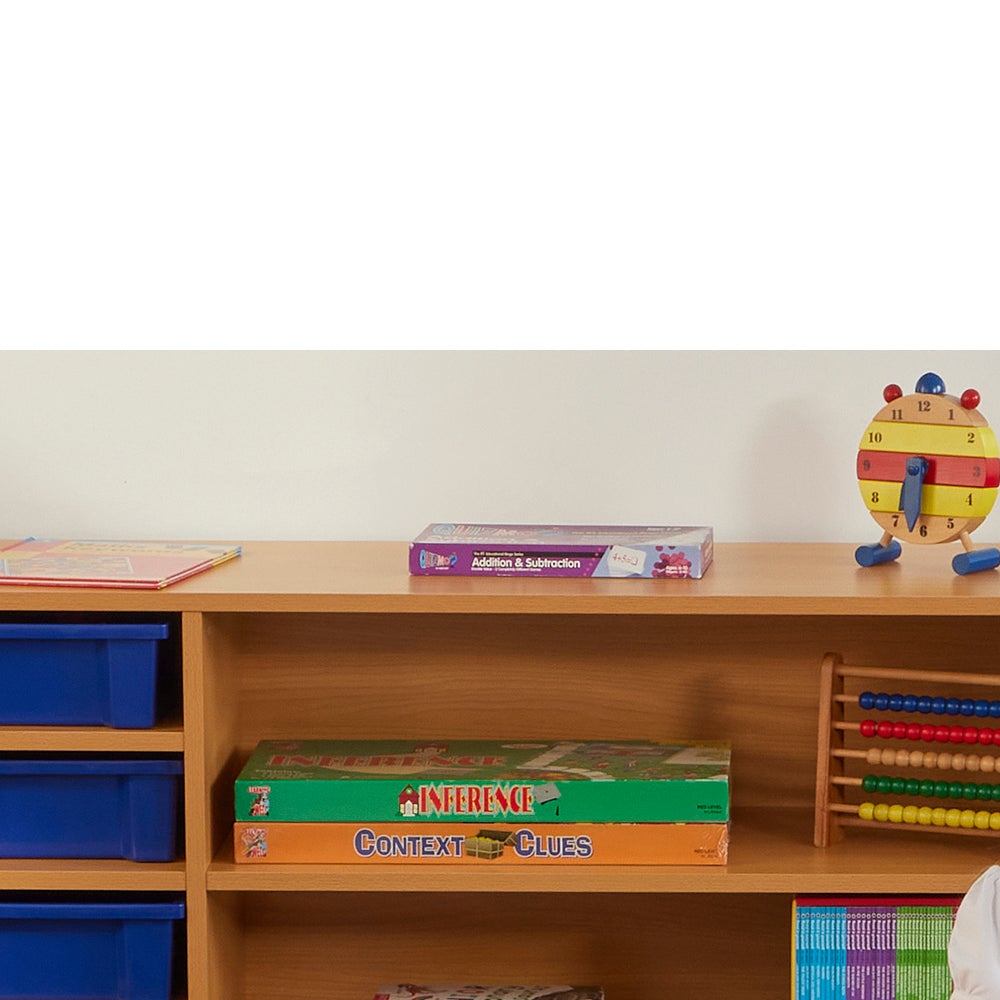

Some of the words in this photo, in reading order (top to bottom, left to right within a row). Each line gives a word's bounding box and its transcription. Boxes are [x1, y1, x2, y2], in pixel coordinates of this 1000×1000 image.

[918, 401, 931, 412] 12
[892, 409, 903, 420] 11
[948, 409, 954, 420] 1
[868, 432, 882, 443] 10
[967, 433, 975, 443] 2
[863, 459, 871, 471] 9
[973, 466, 981, 477] 3
[871, 492, 879, 503] 8
[965, 493, 973, 506] 4
[892, 515, 900, 527] 7
[947, 518, 954, 529] 5
[919, 525, 928, 537] 6
[472, 557, 512, 567] Addition
[515, 557, 523, 567] &
[525, 557, 581, 568] Subtraction
[267, 755, 505, 767] INFERENCE
[419, 784, 534, 815] INFERENCE
[354, 828, 465, 857] CONTEXT
[514, 828, 593, 858] CLUES
